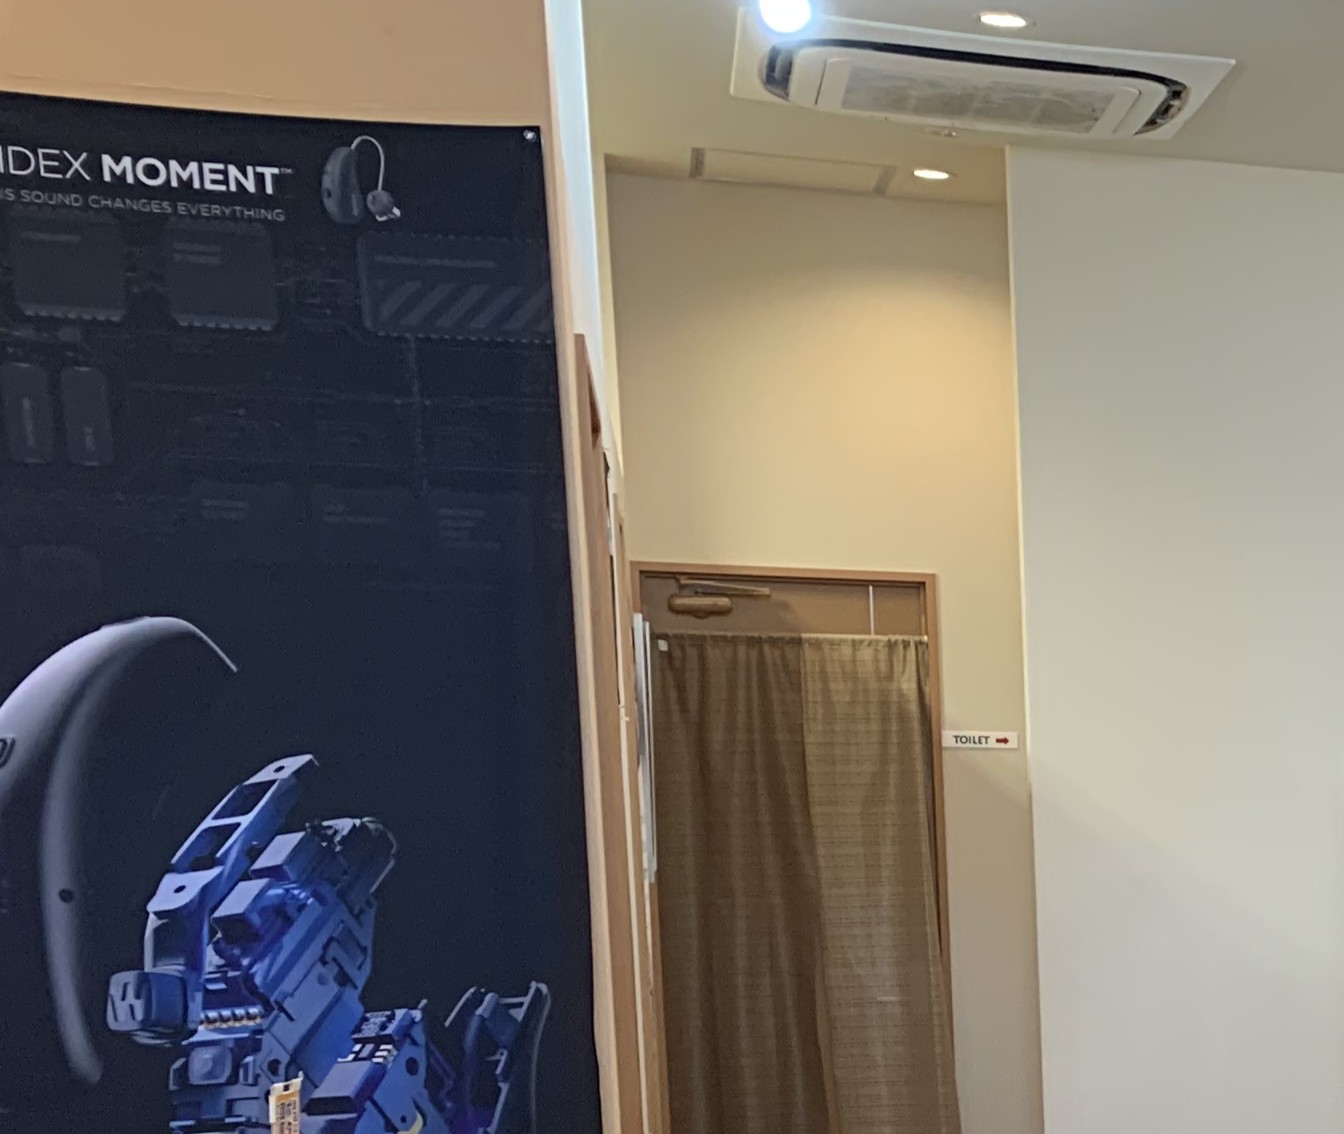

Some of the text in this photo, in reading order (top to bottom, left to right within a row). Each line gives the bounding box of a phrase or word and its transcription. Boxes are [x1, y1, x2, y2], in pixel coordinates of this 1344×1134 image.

[0, 145, 91, 181] IDEX
[20, 189, 83, 207] SOUND
[88, 195, 172, 214] CHANGES
[177, 202, 285, 222] EVERYTHING
[952, 734, 990, 746] TOILET
